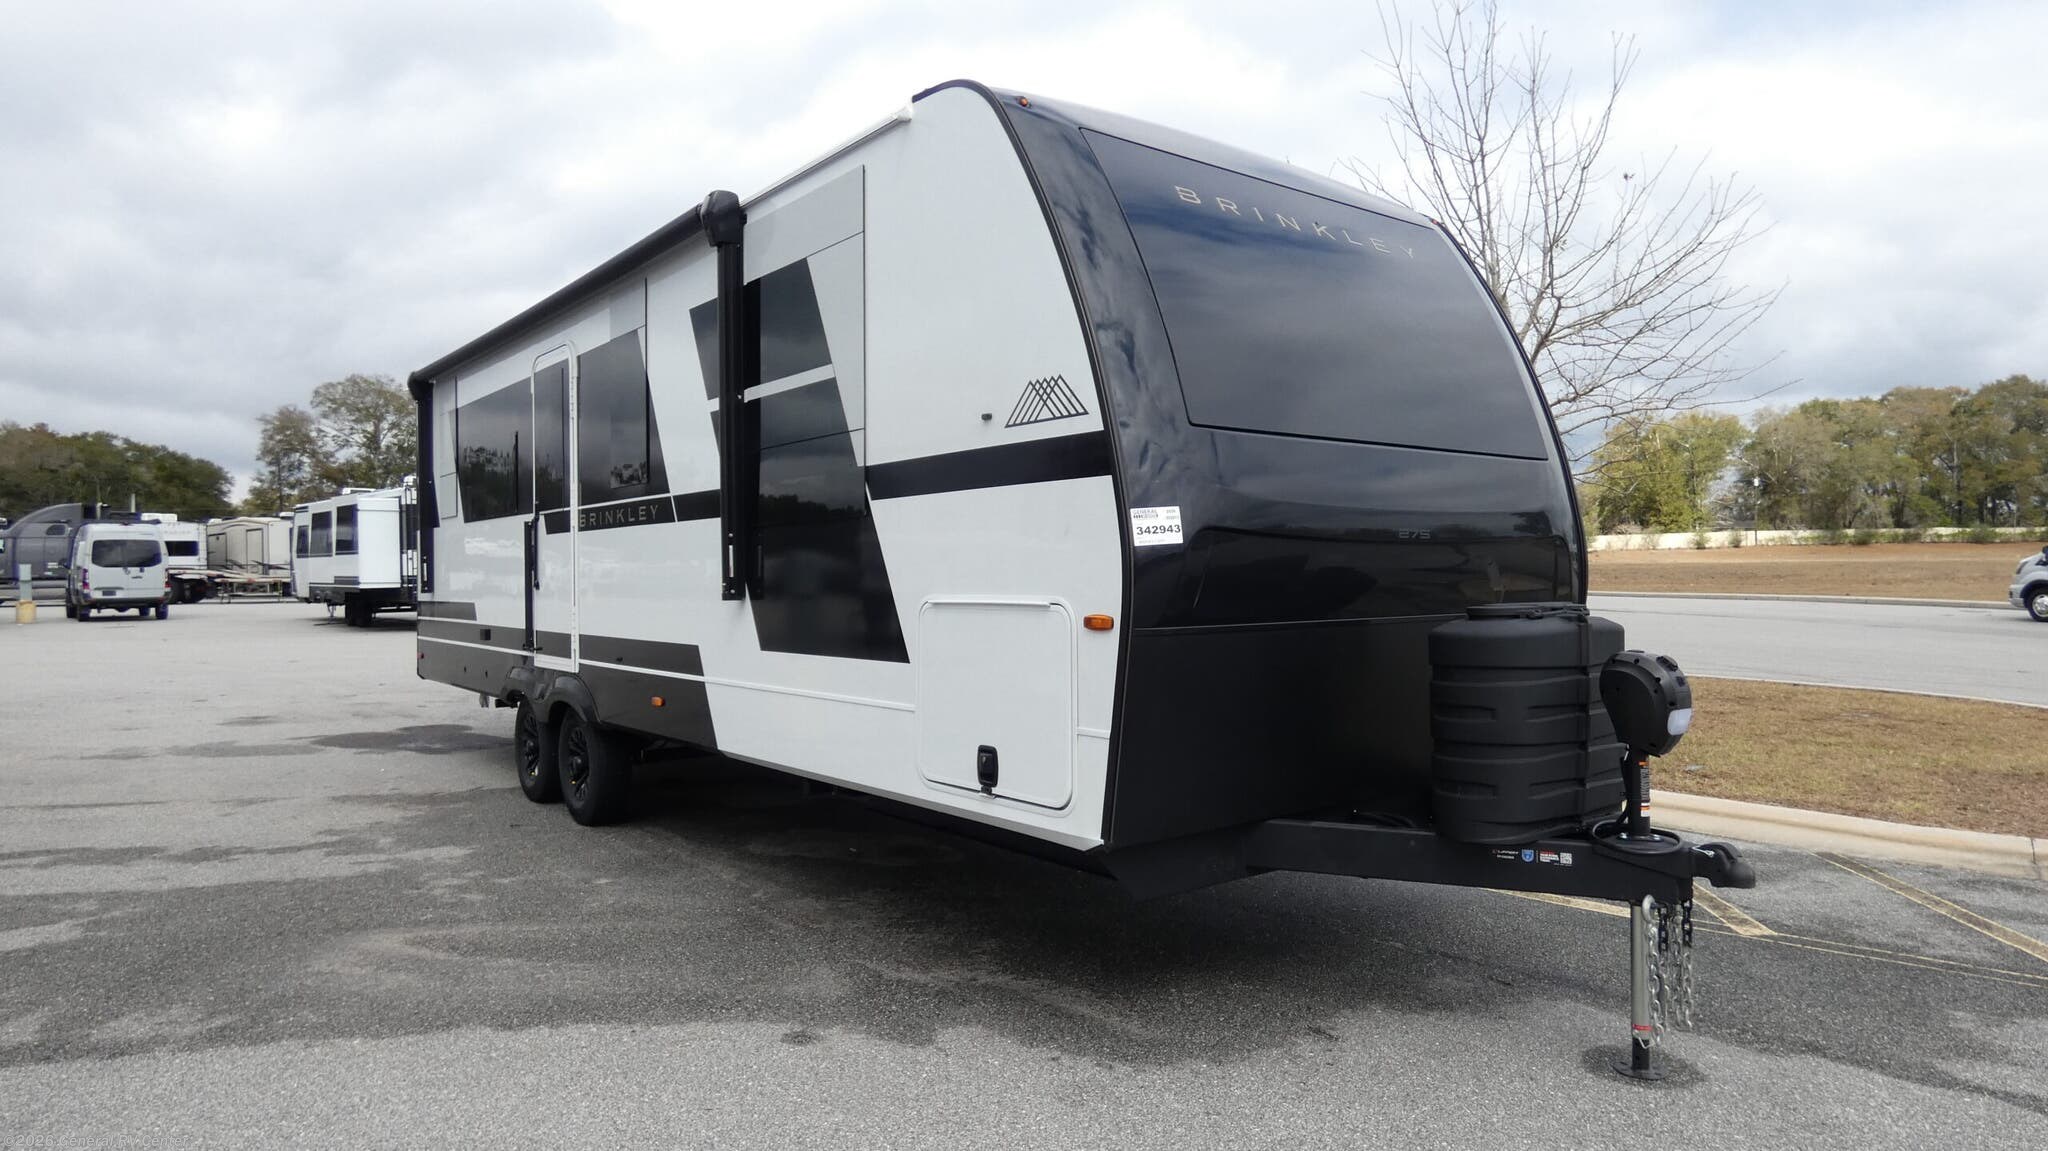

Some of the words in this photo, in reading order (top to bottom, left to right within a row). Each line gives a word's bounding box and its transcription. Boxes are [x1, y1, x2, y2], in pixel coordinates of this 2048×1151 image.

[1174, 186, 1414, 259] BRINKLEY
[579, 505, 659, 527] BRINKLEY
[1136, 524, 1181, 535] 342943
